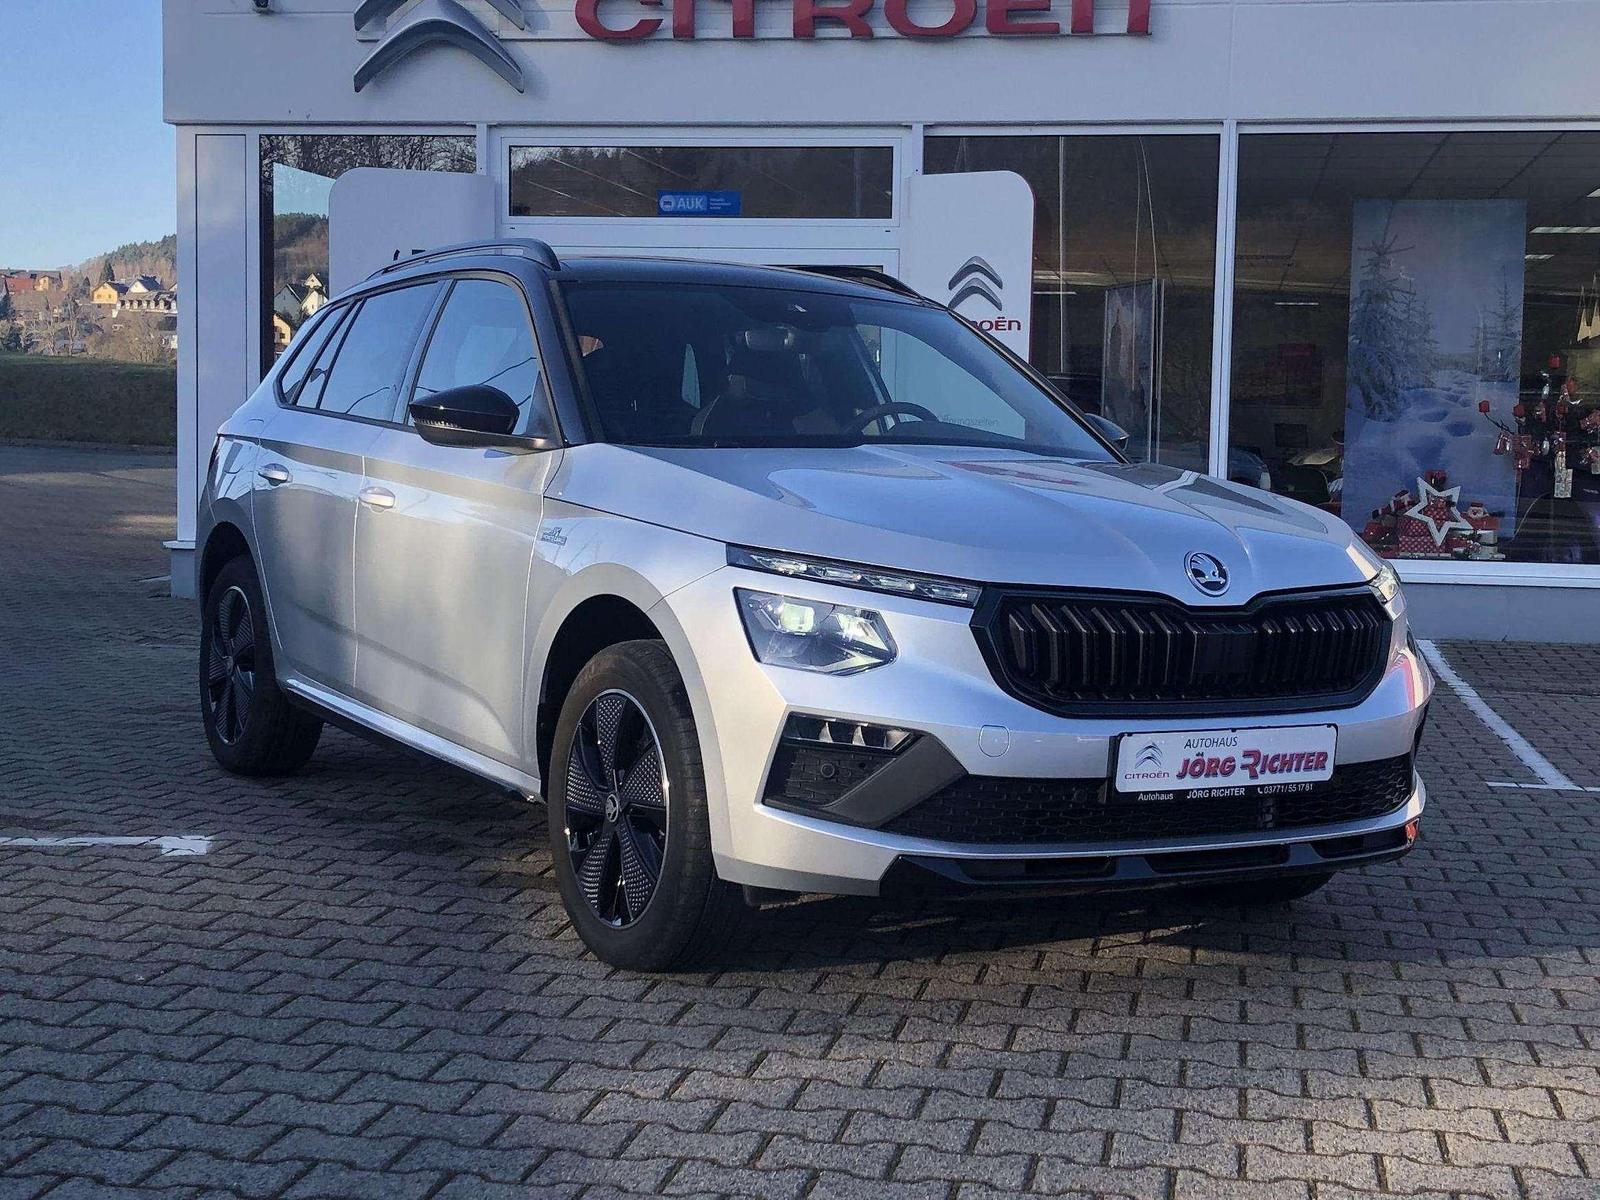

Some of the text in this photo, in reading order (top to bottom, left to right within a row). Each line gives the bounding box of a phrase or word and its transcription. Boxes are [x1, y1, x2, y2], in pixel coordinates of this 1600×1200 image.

[677, 197, 704, 210] AUK
[1184, 736, 1238, 749] AUTOHAUS
[1176, 748, 1329, 780] JÖRG RICHTER
[1124, 770, 1170, 780] CITROËN
[1138, 792, 1174, 801] Autohaus
[1211, 787, 1246, 798] RICHTER
